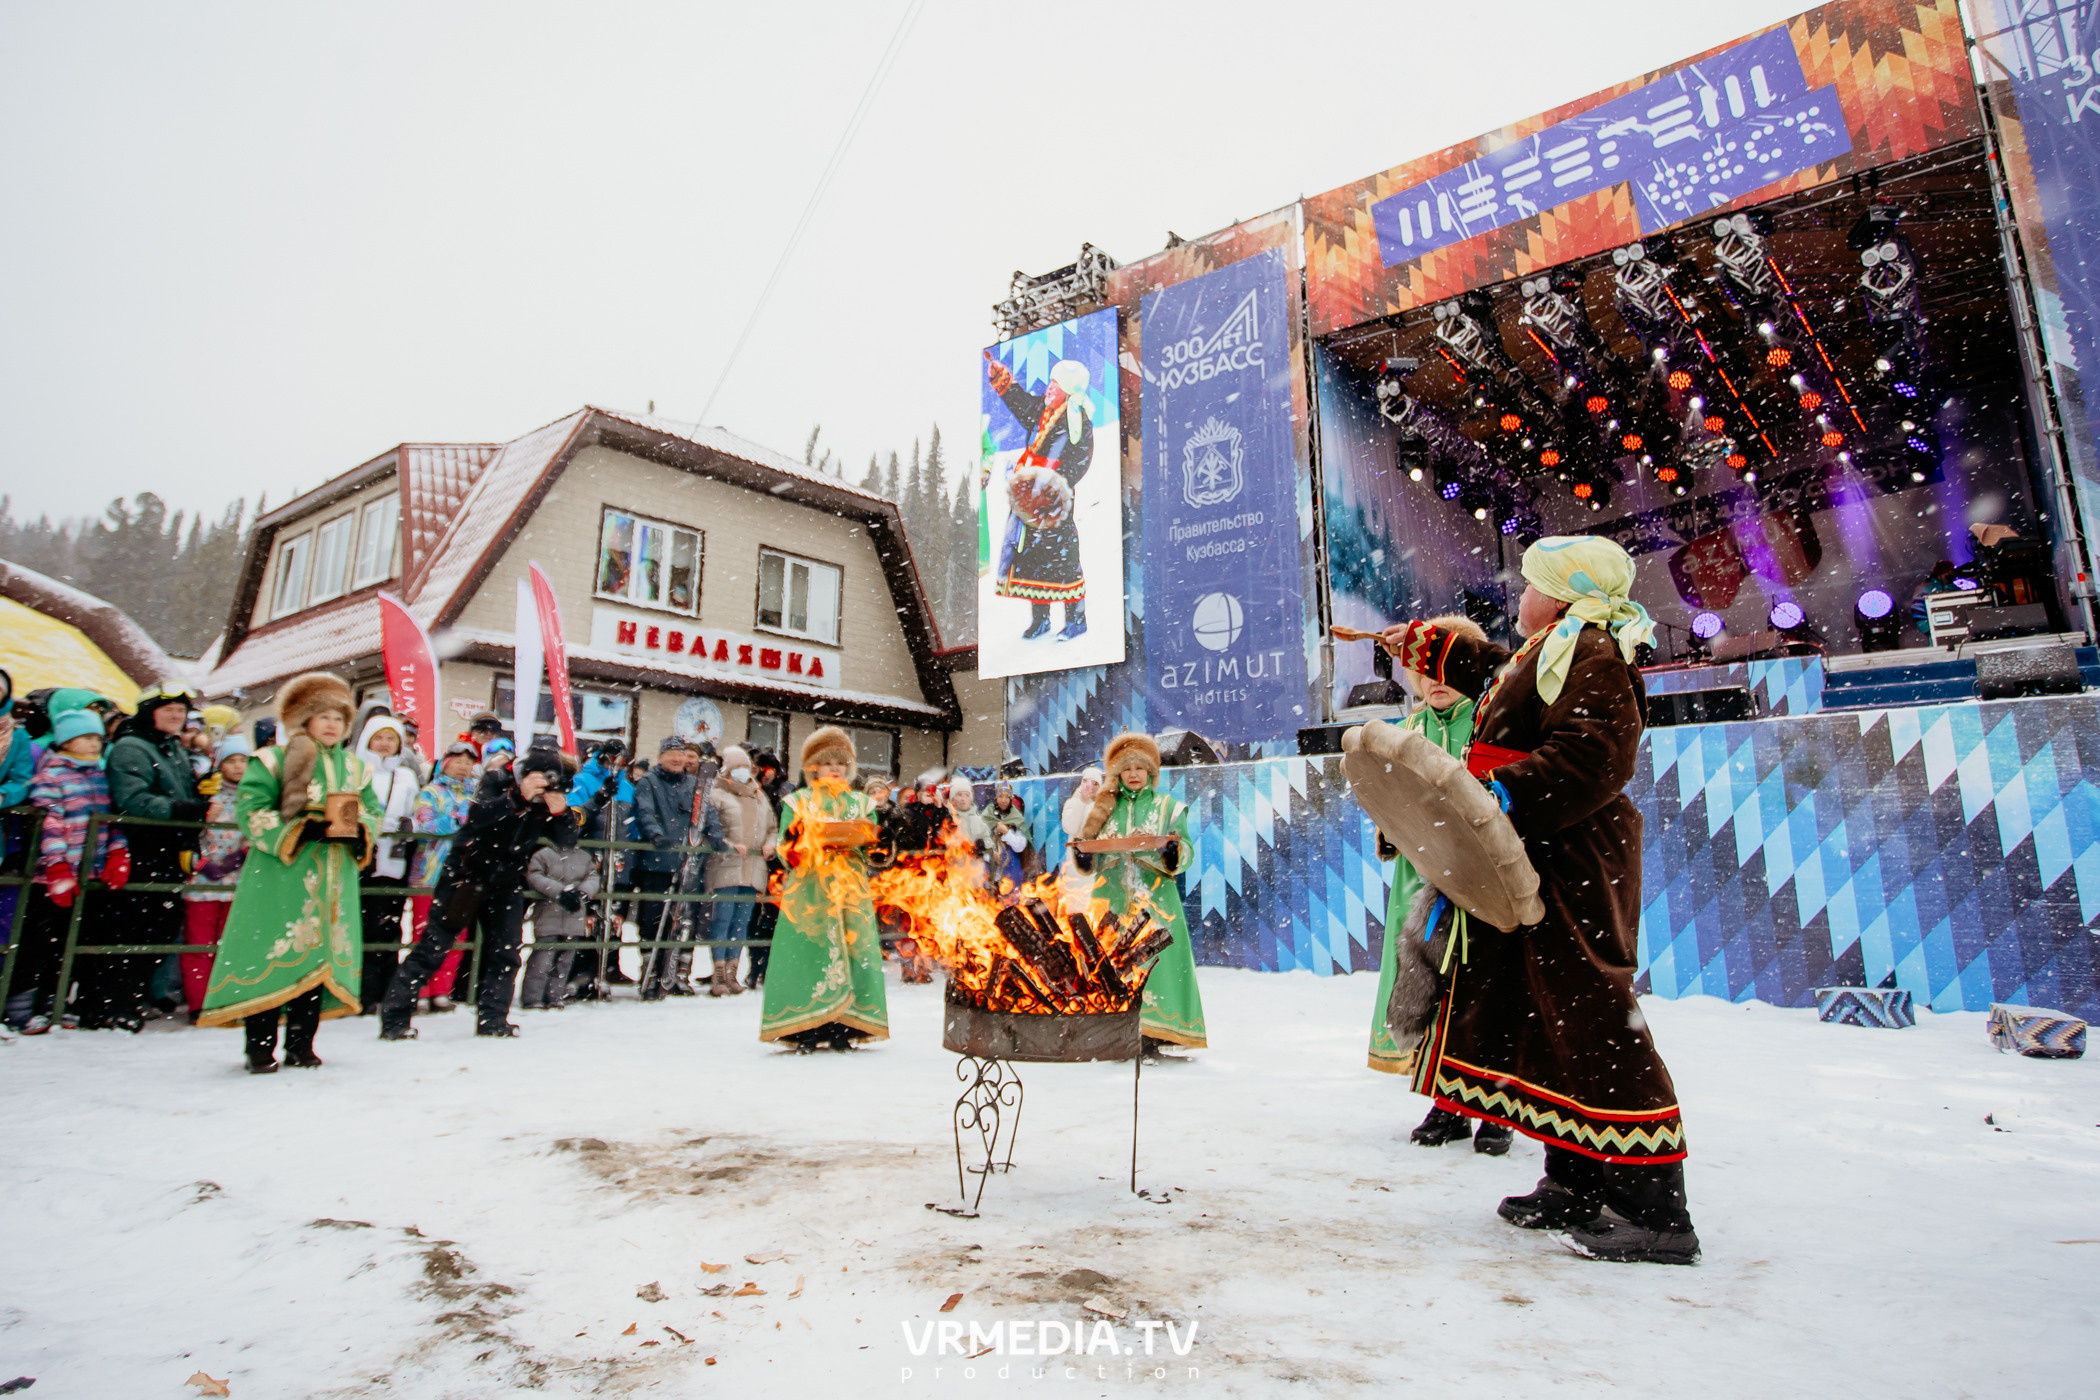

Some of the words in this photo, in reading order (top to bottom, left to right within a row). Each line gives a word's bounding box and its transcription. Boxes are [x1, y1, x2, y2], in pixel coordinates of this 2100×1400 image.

[1160, 335, 1205, 368] 300
[1160, 341, 1265, 393] КУЗБАСС
[1169, 511, 1264, 543] Правительство
[1186, 538, 1245, 563] Кузбасса
[616, 620, 824, 678] НЕВАЛЯШКА
[400, 663, 417, 716] TUM
[1194, 688, 1248, 706] HOTELS
